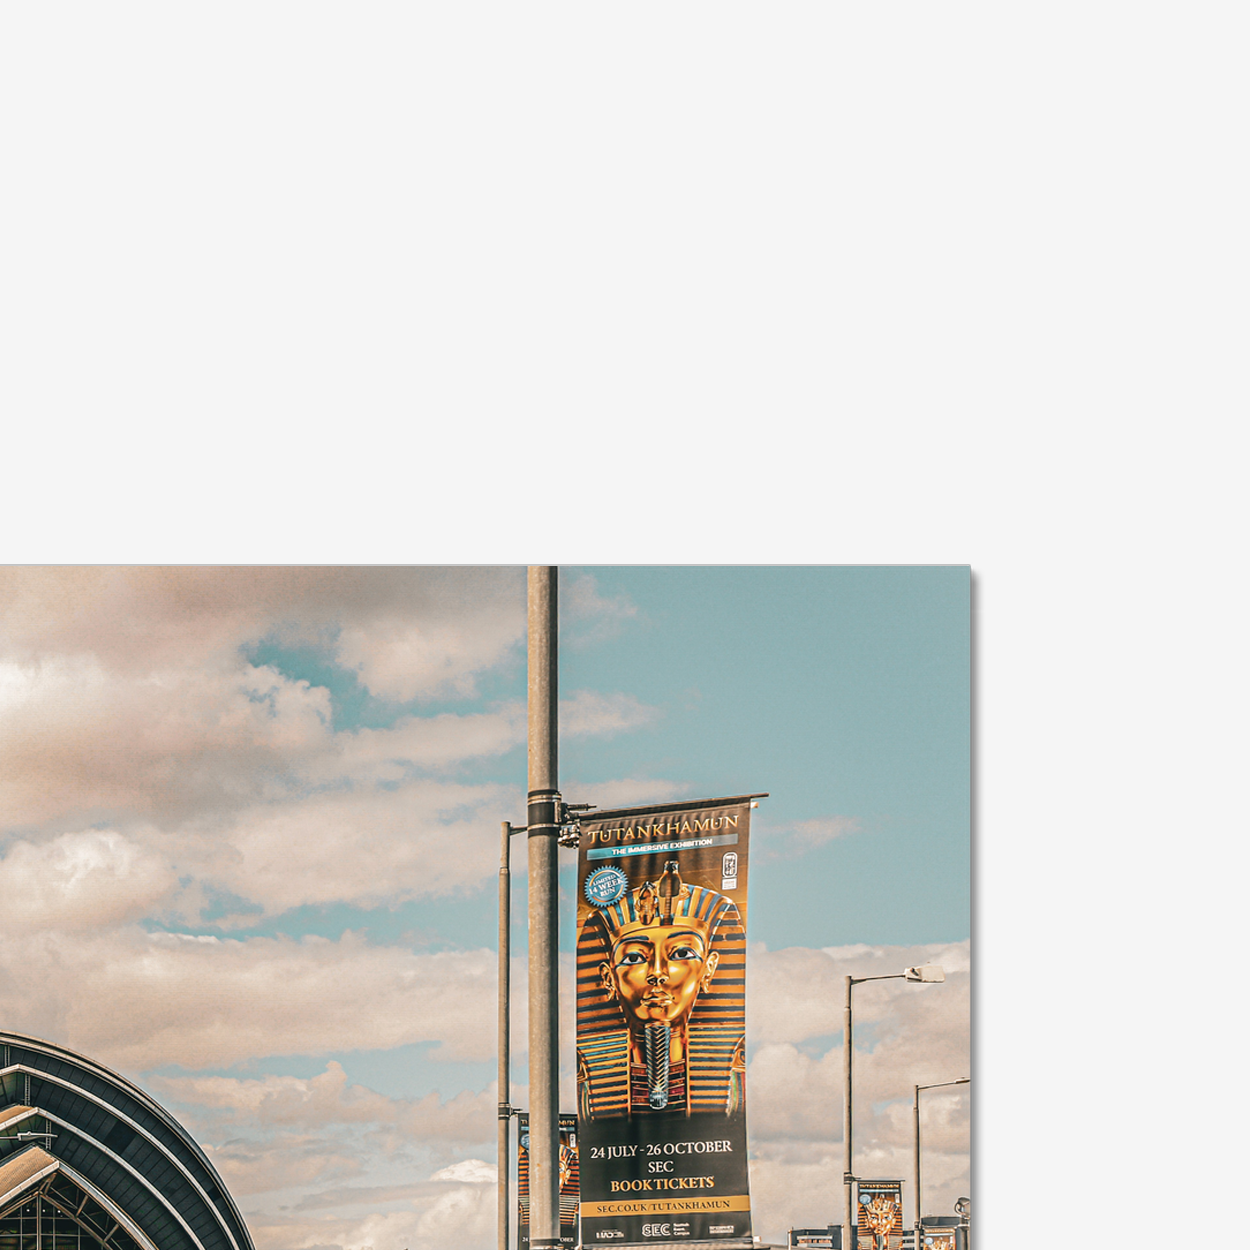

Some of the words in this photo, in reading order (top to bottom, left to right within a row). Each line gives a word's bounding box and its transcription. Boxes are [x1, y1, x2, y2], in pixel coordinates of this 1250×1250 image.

[587, 815, 739, 843] TUTANKHAMUN
[611, 847, 627, 856] THE
[628, 843, 669, 854] IMMERSIVE
[669, 838, 713, 850] EXHIBITION
[589, 886, 598, 895] 14
[598, 877, 625, 891] WEEK
[600, 886, 616, 897] RUN
[590, 1147, 605, 1159] 24
[608, 1145, 638, 1160] JULY
[646, 1143, 662, 1156] 26
[663, 1140, 733, 1156] OCTOBER
[648, 1160, 674, 1174] SEC
[610, 1179, 653, 1192] BOOK
[653, 1176, 715, 1190] TICKETS
[597, 1200, 731, 1213] SEC.CO.UK/TUTANKHAMUN
[642, 1222, 671, 1238] SEC
